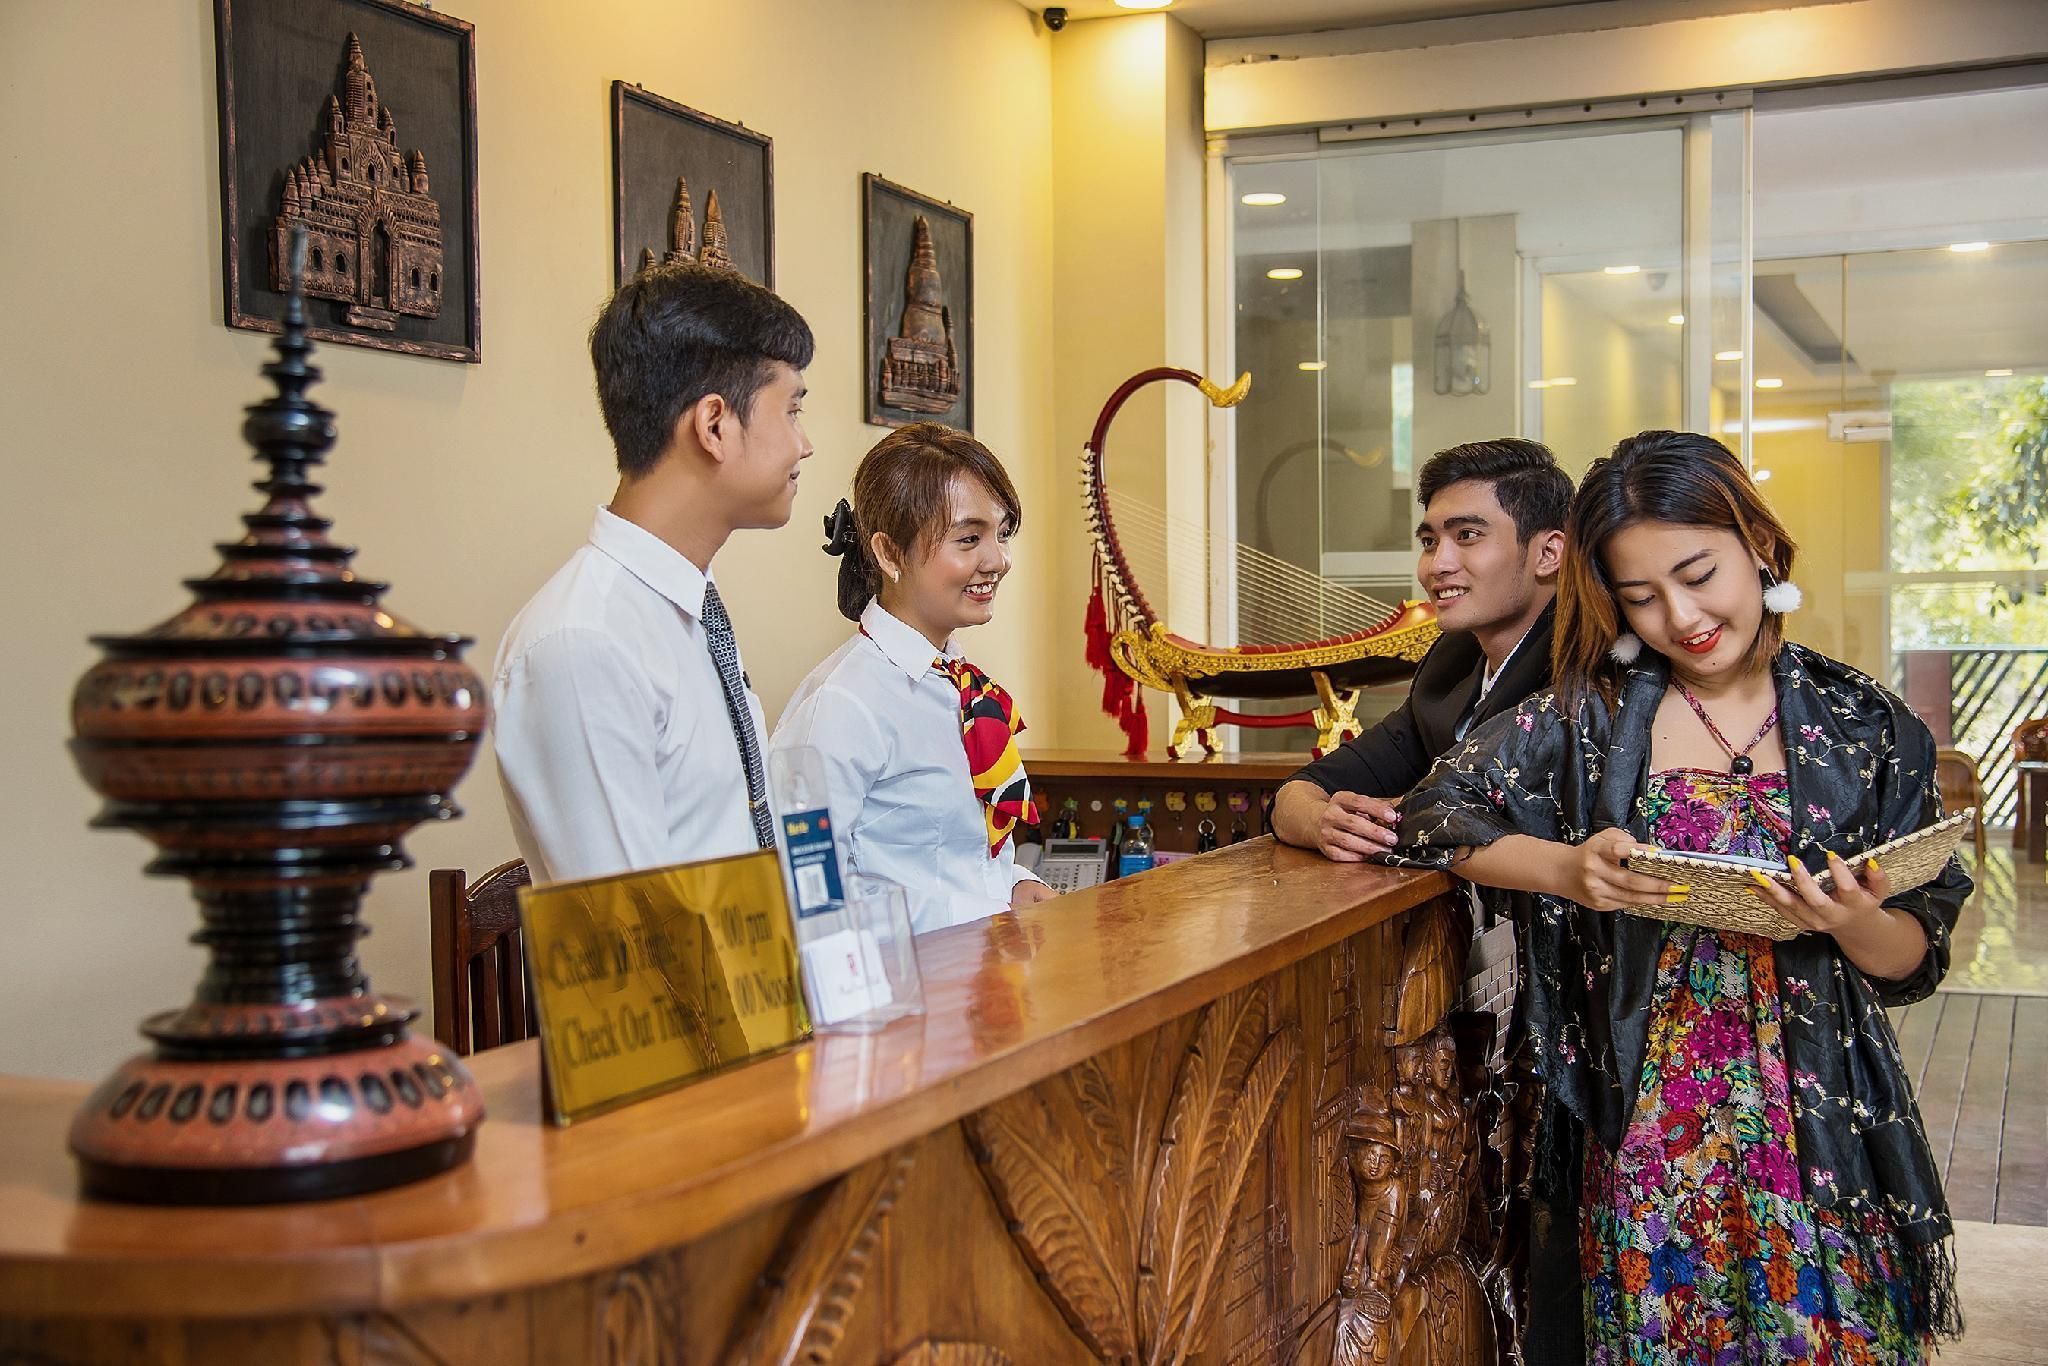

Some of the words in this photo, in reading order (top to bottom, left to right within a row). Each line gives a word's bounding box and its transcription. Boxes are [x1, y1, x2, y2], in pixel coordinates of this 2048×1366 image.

[746, 911, 774, 956] pm
[561, 1008, 620, 1069] Check
[619, 997, 655, 1052] Out
